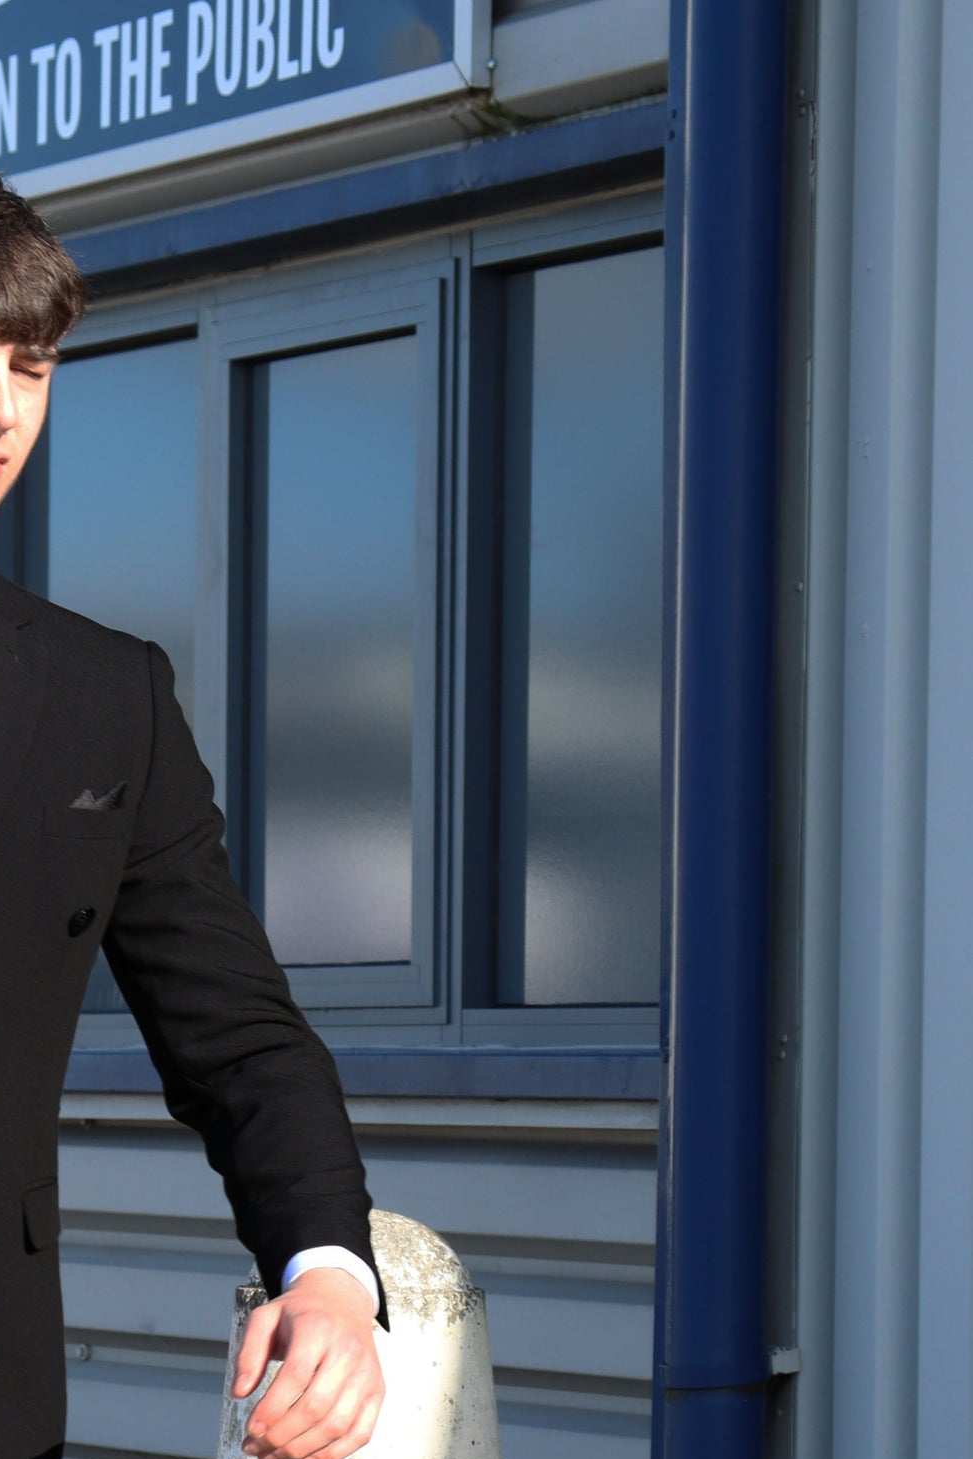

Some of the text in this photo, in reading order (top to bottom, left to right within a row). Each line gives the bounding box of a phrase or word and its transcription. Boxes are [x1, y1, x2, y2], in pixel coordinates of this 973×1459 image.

[30, 36, 82, 146] TO
[93, 8, 174, 130] THE
[186, 0, 345, 106] PUBLIC
